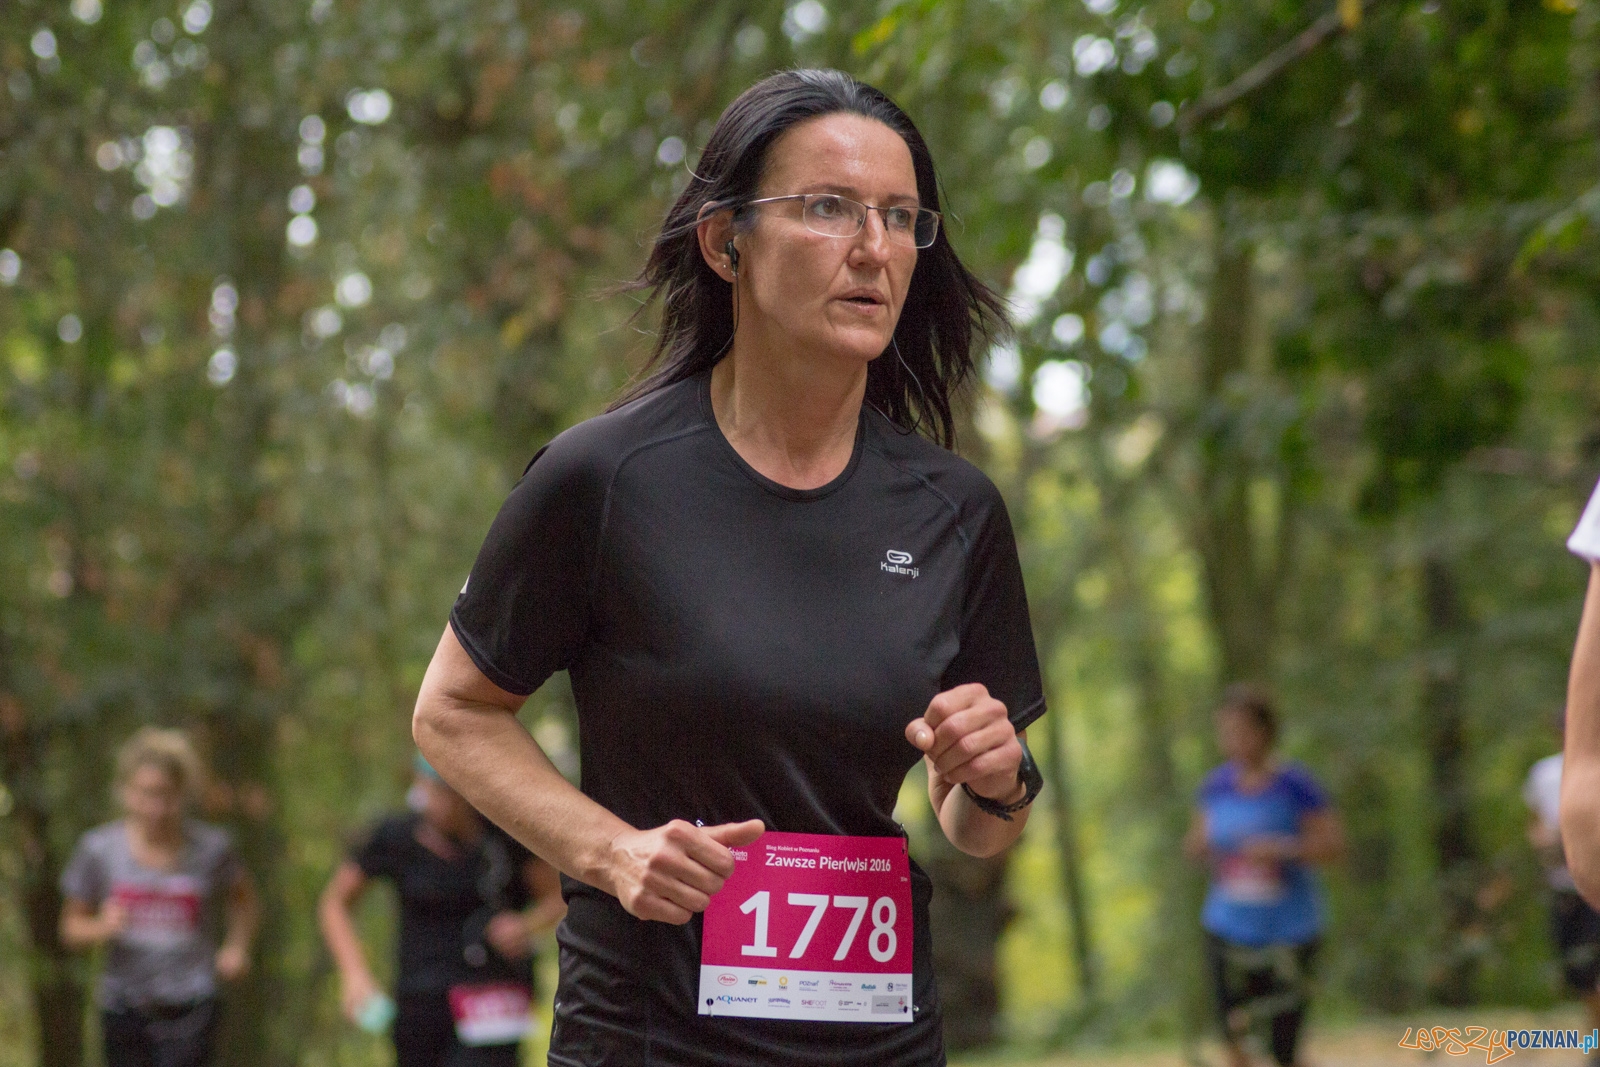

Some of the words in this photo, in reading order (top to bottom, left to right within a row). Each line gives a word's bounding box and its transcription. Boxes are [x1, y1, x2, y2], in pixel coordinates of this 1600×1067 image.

[765, 852, 816, 868] Zawsze
[819, 856, 868, 873] Pier(w)si
[869, 858, 891, 871] 2016
[739, 890, 897, 963] 1778
